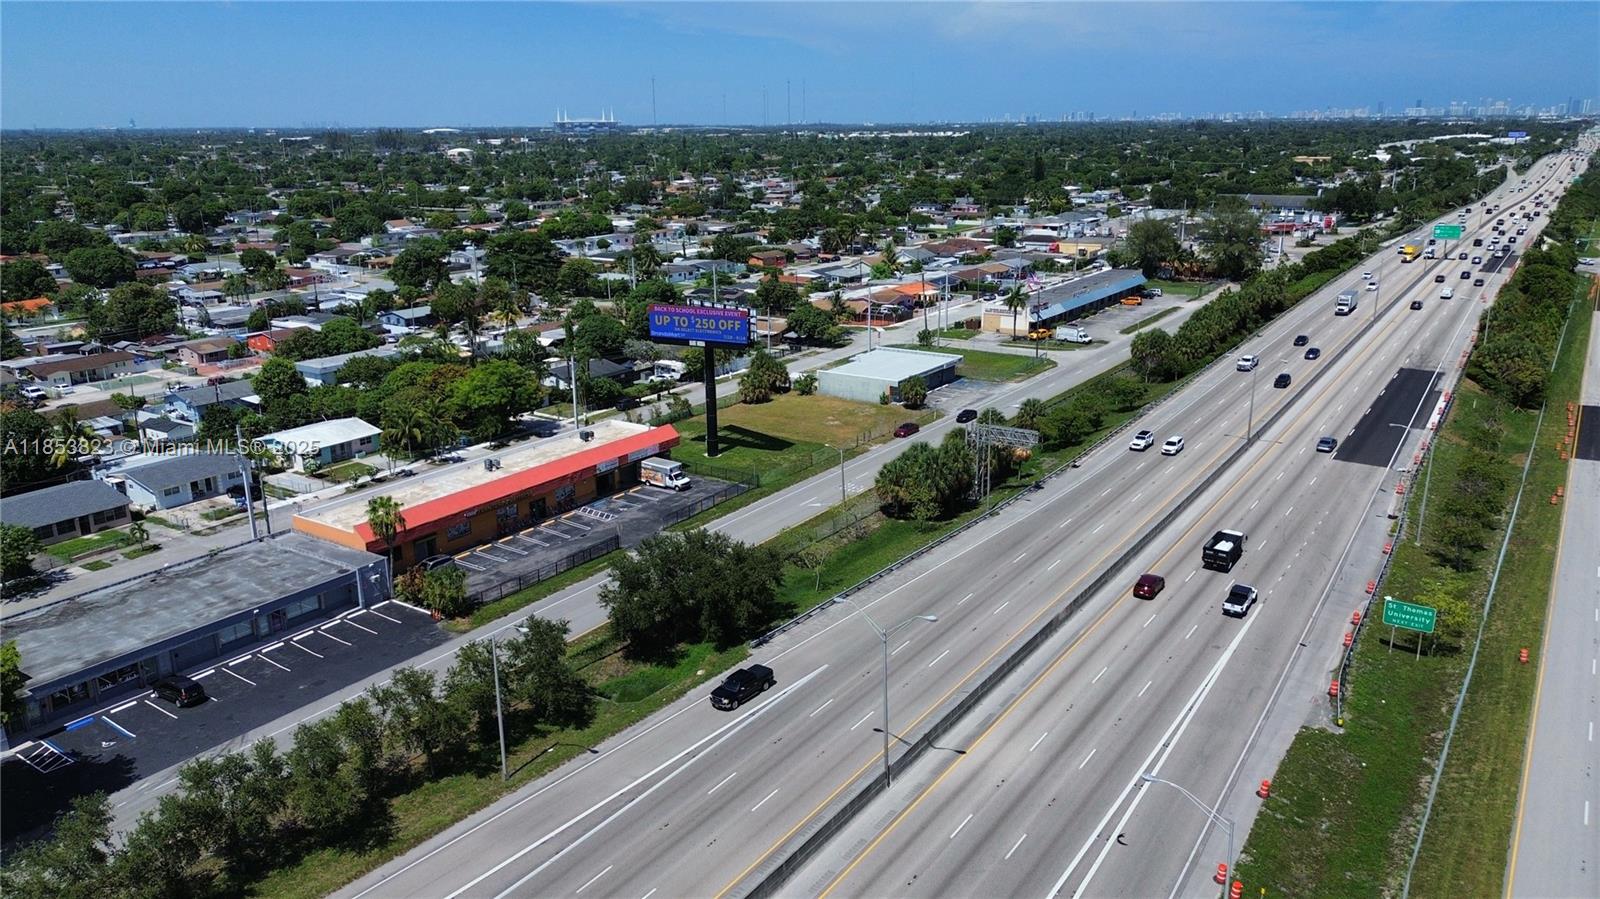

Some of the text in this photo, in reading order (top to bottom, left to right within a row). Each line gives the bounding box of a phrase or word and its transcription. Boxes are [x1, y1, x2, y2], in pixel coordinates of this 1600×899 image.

[655, 314, 741, 331] UP TO $250 OFF
[1387, 610, 1431, 625] University
[1403, 606, 1433, 616] Thomas
